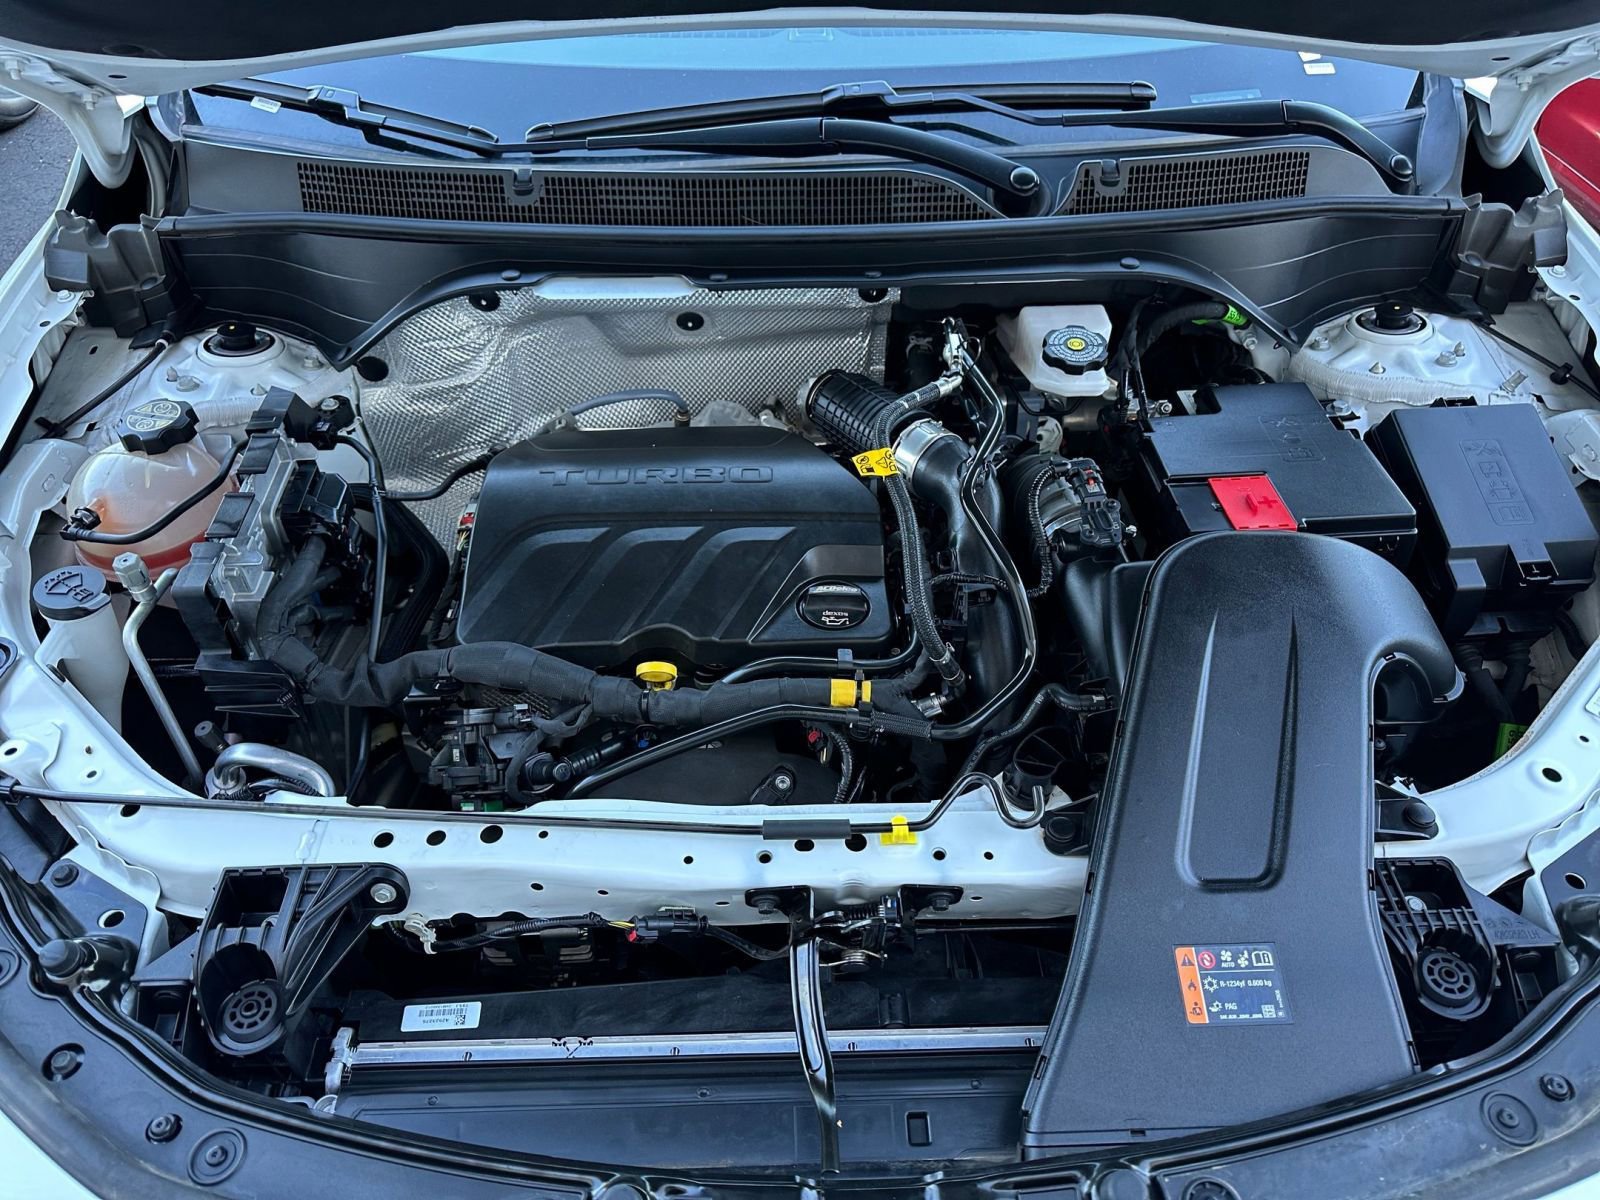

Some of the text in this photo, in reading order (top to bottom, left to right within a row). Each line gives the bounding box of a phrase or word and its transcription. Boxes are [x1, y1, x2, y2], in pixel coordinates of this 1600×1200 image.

[539, 466, 774, 486] TURBO
[816, 585, 858, 593] ACDelco
[1224, 1002, 1238, 1010] PAG
